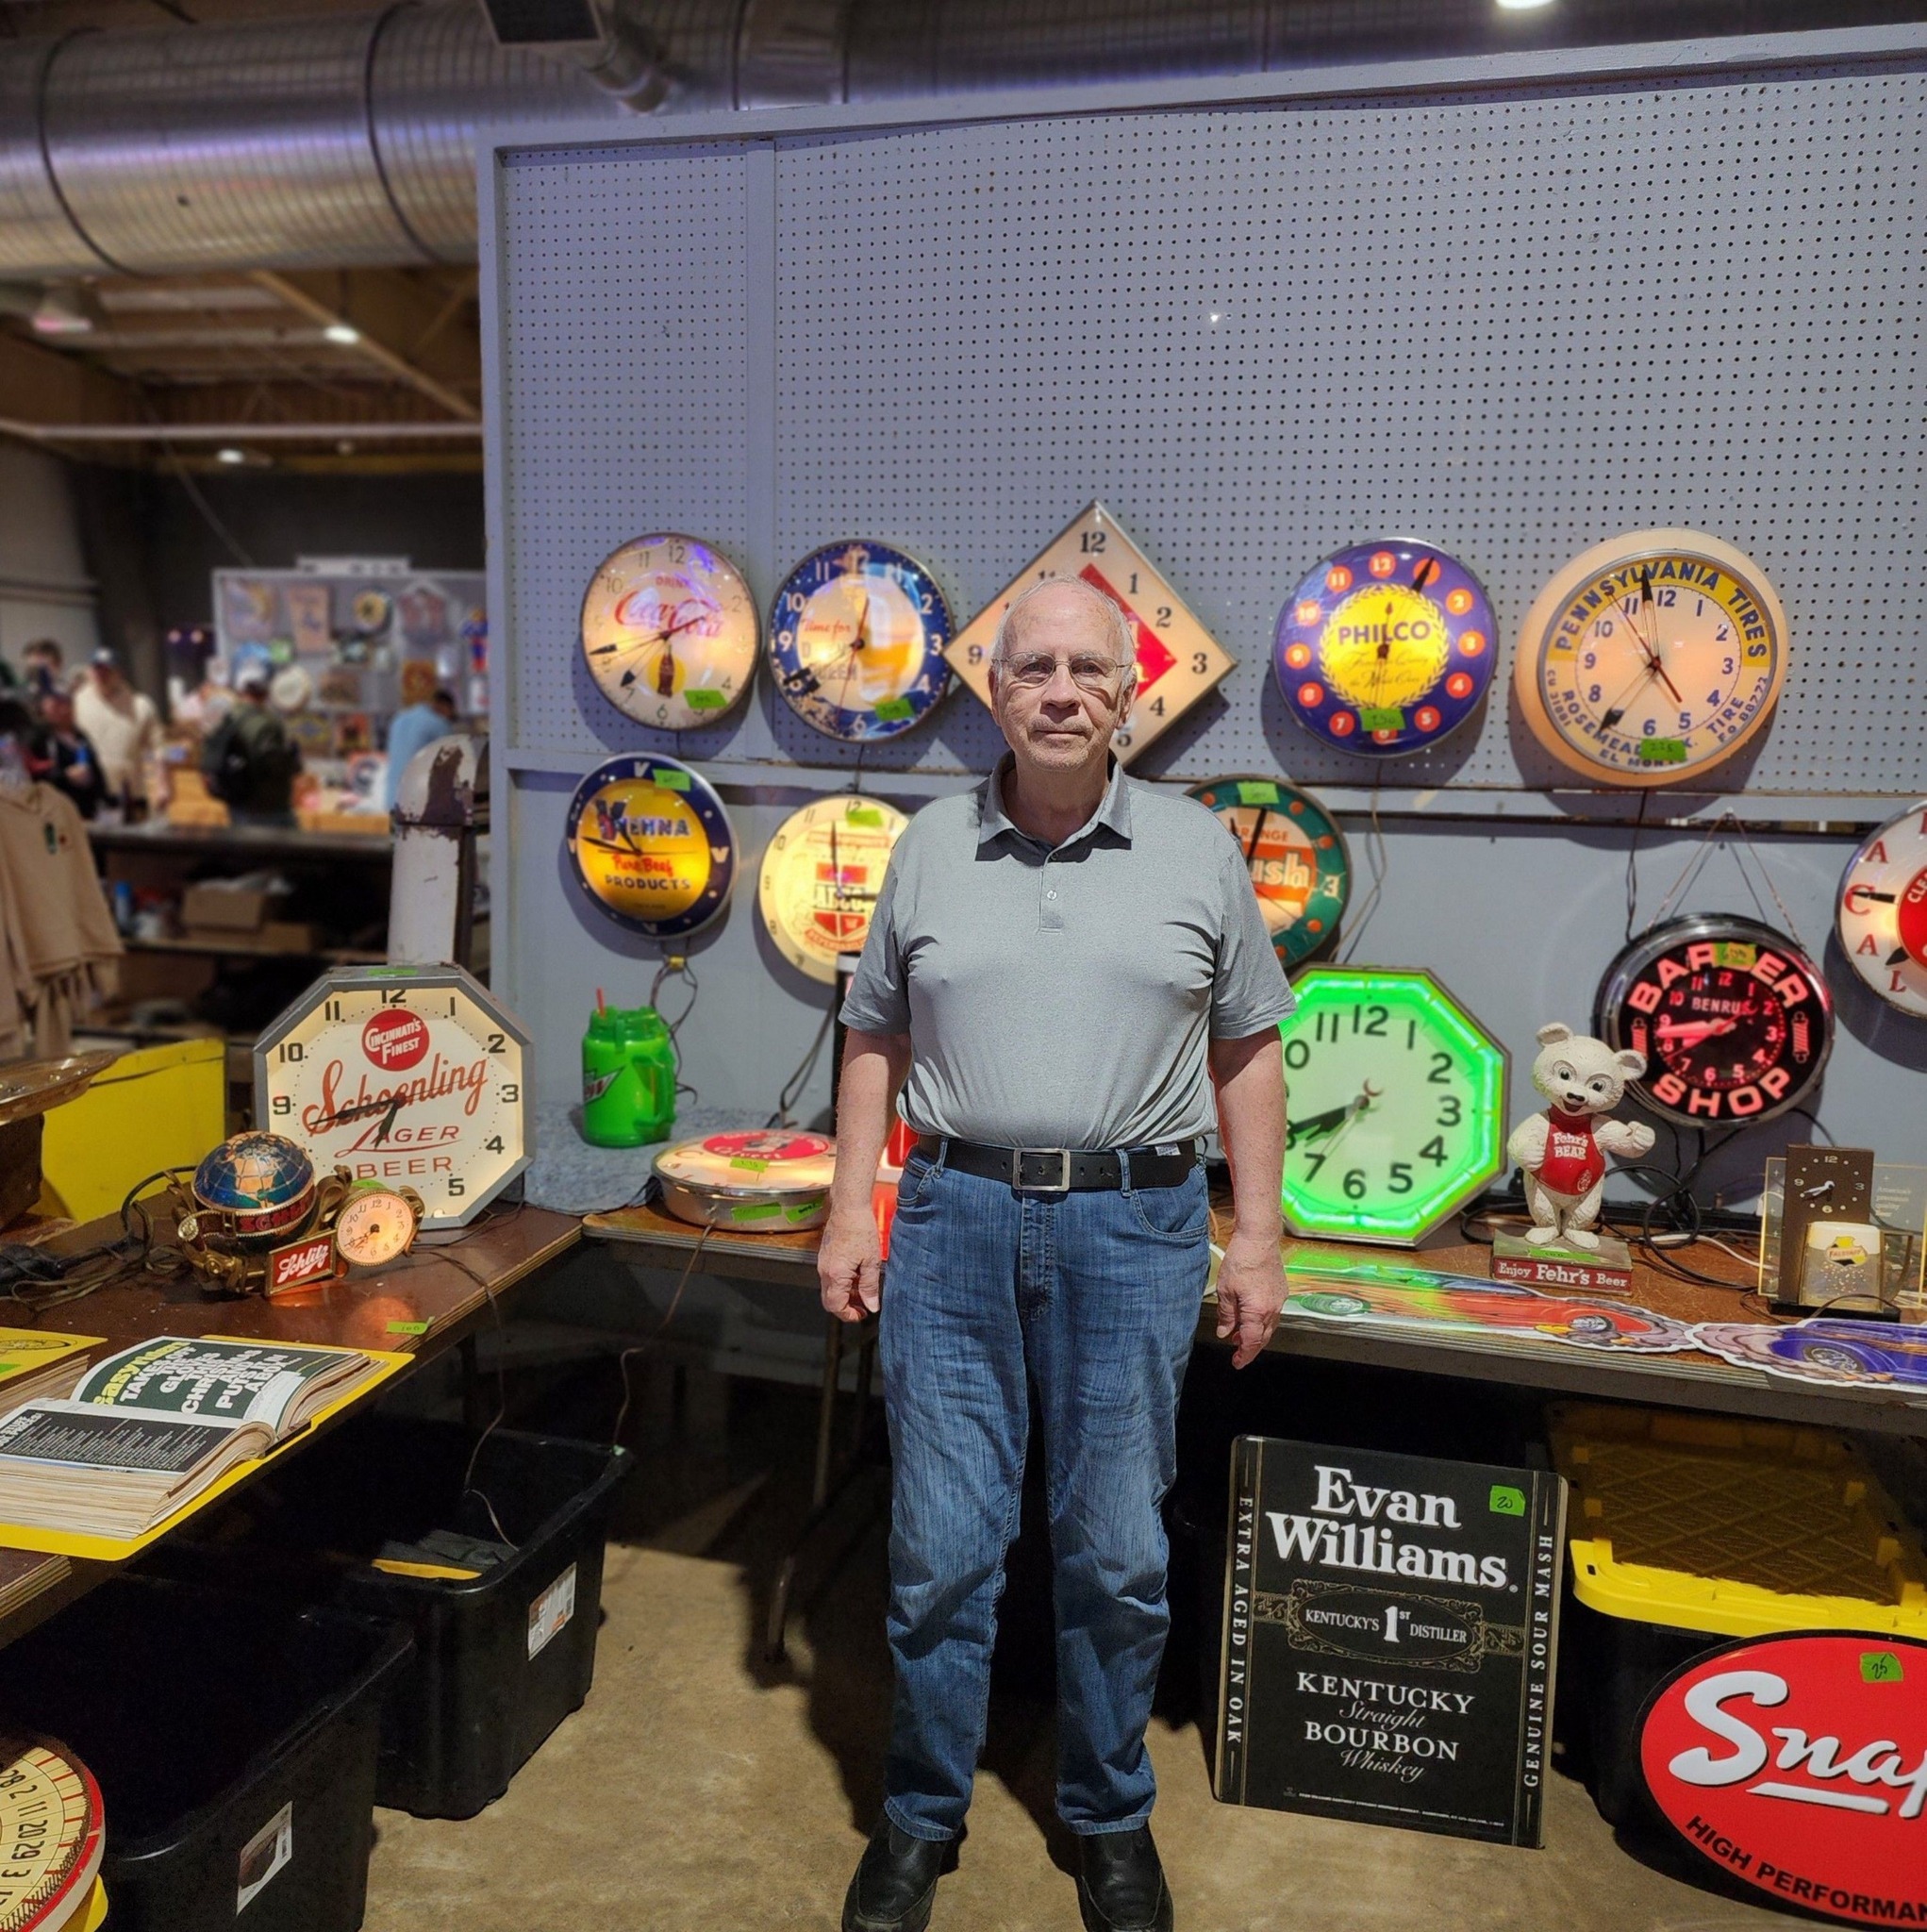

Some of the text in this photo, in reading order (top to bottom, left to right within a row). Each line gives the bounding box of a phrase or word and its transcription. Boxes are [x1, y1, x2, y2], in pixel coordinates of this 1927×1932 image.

[1080, 532, 1105, 553] 12
[639, 551, 650, 568] 11
[669, 545, 685, 564] 12
[816, 562, 829, 580] 11
[1373, 558, 1393, 572] 12
[606, 576, 623, 594] 10
[1129, 574, 1139, 594] 1
[1331, 573, 1346, 587] 11
[786, 593, 805, 611] 10
[921, 594, 933, 613] 2
[1454, 595, 1465, 608] 2
[1624, 598, 1639, 615] 11
[1657, 590, 1677, 608] 12
[1696, 599, 1703, 617] 1
[1156, 608, 1172, 627] 2
[1300, 607, 1317, 621] 10
[1555, 560, 1768, 658] PENNSYLVANIA TIRES
[1338, 621, 1432, 645] PHILCO
[1594, 621, 1613, 639] 10
[1716, 624, 1729, 641] 2
[778, 631, 793, 652] 9
[930, 635, 943, 656] 3
[968, 645, 983, 666] 9
[1192, 653, 1207, 674] 3
[1584, 653, 1596, 670] 9
[1721, 658, 1734, 675] 3
[722, 676, 732, 690] 4
[918, 675, 931, 693] 4
[1453, 678, 1466, 691] 4
[1588, 684, 1602, 703] 8
[1706, 689, 1721, 708] 4
[656, 704, 668, 720] 6
[1150, 696, 1166, 717] 4
[1706, 697, 1744, 735] TIRE
[853, 715, 866, 734] 6
[1336, 717, 1347, 730] 7
[1642, 719, 1656, 737] 6
[1678, 712, 1692, 730] 5
[1600, 749, 1619, 764] EL
[594, 799, 690, 841] VENNA
[1237, 825, 1289, 841] RNGE
[605, 874, 690, 891] PRODUCTS
[1627, 943, 1809, 1015] BARER
[1718, 972, 1734, 987] 12
[381, 989, 407, 1004] 12
[1670, 991, 1685, 1006] 10
[1692, 997, 1751, 1015] BENRUS
[325, 1001, 341, 1021] 11
[449, 997, 457, 1016] 1
[1763, 1001, 1773, 1015] 2
[1316, 1012, 1339, 1043] 11
[1353, 1005, 1389, 1037] 12
[365, 1018, 423, 1052] CINCINNATI'S
[1407, 1020, 1416, 1050] 1
[1766, 1026, 1777, 1041] 3
[279, 1042, 303, 1063] 10
[382, 1037, 421, 1065] FINEST
[488, 1034, 507, 1054] 2
[1284, 1039, 1310, 1070] 0
[1753, 1049, 1765, 1063] 4
[1427, 1052, 1454, 1084] 2
[1704, 1067, 1716, 1081] 6
[1733, 1064, 1744, 1078] 5
[302, 1052, 489, 1138] Schoenling
[501, 1084, 519, 1104] 3
[1652, 1067, 1790, 1117] SHOP
[273, 1095, 291, 1115] 9
[1436, 1095, 1462, 1127] 3
[334, 1121, 462, 1158] LAGER
[486, 1135, 506, 1155] 4
[1553, 1132, 1588, 1148] Fehr's
[1419, 1135, 1449, 1168] 4
[1553, 1144, 1586, 1160] BEAR
[1824, 1156, 1838, 1164] 12
[357, 1157, 453, 1179] BEER
[1304, 1152, 1327, 1183] 7
[448, 1178, 466, 1196] 5
[1342, 1169, 1367, 1200] 6
[1387, 1162, 1413, 1194] 5
[1794, 1178, 1804, 1187] 9
[1854, 1182, 1865, 1191] 3
[1821, 1205, 1834, 1214] 6
[276, 1244, 329, 1284] Schlitz
[1499, 1261, 1628, 1289] Enjoy Fehr's Beer
[1311, 1464, 1462, 1529] Evan
[1265, 1511, 1508, 1590] Williams
[1227, 1496, 1254, 1743] EXTRA AGED IN OAK
[1305, 1608, 1380, 1632] KENTUCKY'S
[1409, 1624, 1468, 1644] DISTILLER
[1523, 1534, 1553, 1788] GENUINE SOUR MASH
[1296, 1671, 1476, 1716] KENTUCKY
[1339, 1701, 1427, 1732] Straight
[1304, 1721, 1459, 1762] BOURBON
[1340, 1749, 1426, 1783] Whiskey
[8, 1785, 38, 1800] 2
[17, 1820, 48, 1840] 20
[11, 1840, 45, 1861] 29
[1685, 1815, 1753, 1871] HIGH
